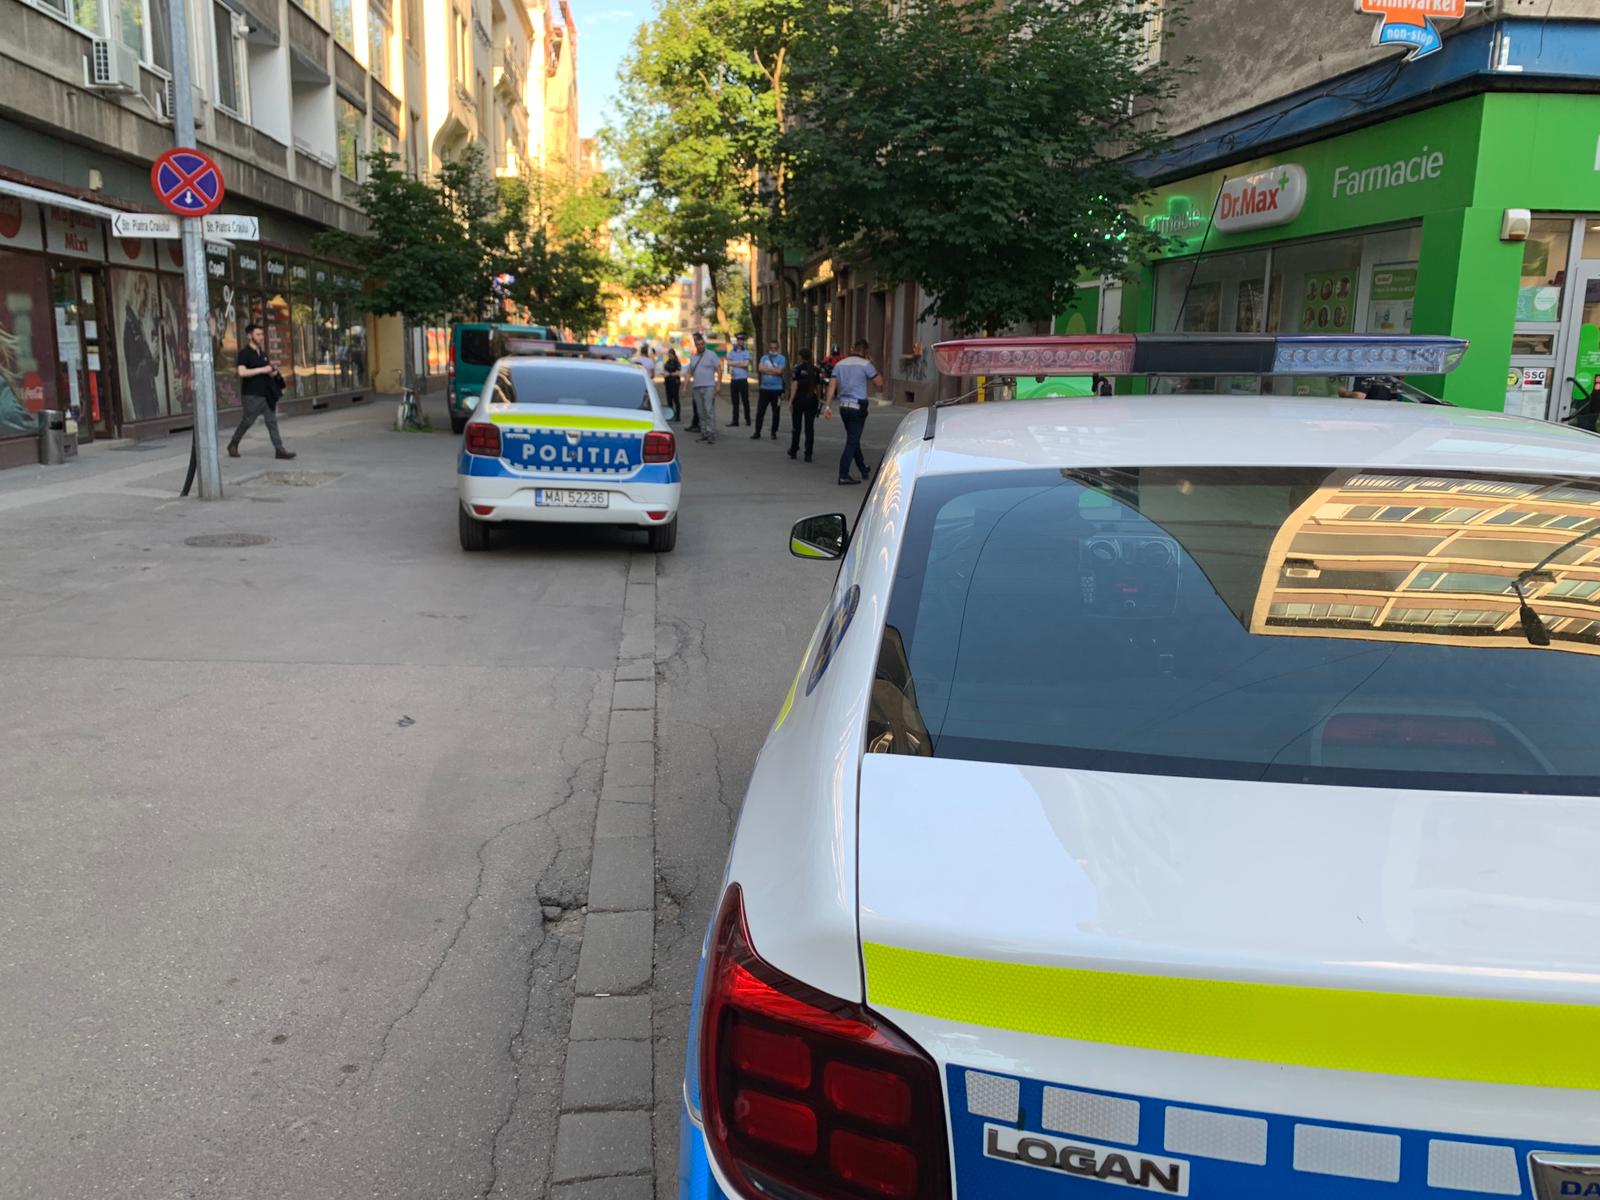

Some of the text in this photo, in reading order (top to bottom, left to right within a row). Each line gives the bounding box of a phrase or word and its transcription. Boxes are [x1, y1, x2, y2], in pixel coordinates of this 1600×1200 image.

[1386, 28, 1434, 45] non-stop
[1332, 145, 1444, 198] Farmacie
[1220, 186, 1280, 220] Dr.Max
[132, 219, 148, 231] Piatra
[64, 232, 88, 252] Mixt
[1523, 371, 1545, 380] SSG
[522, 444, 629, 465] POLITIA
[544, 490, 605, 504] MAI 52236
[987, 1128, 1180, 1193] LOGAN
